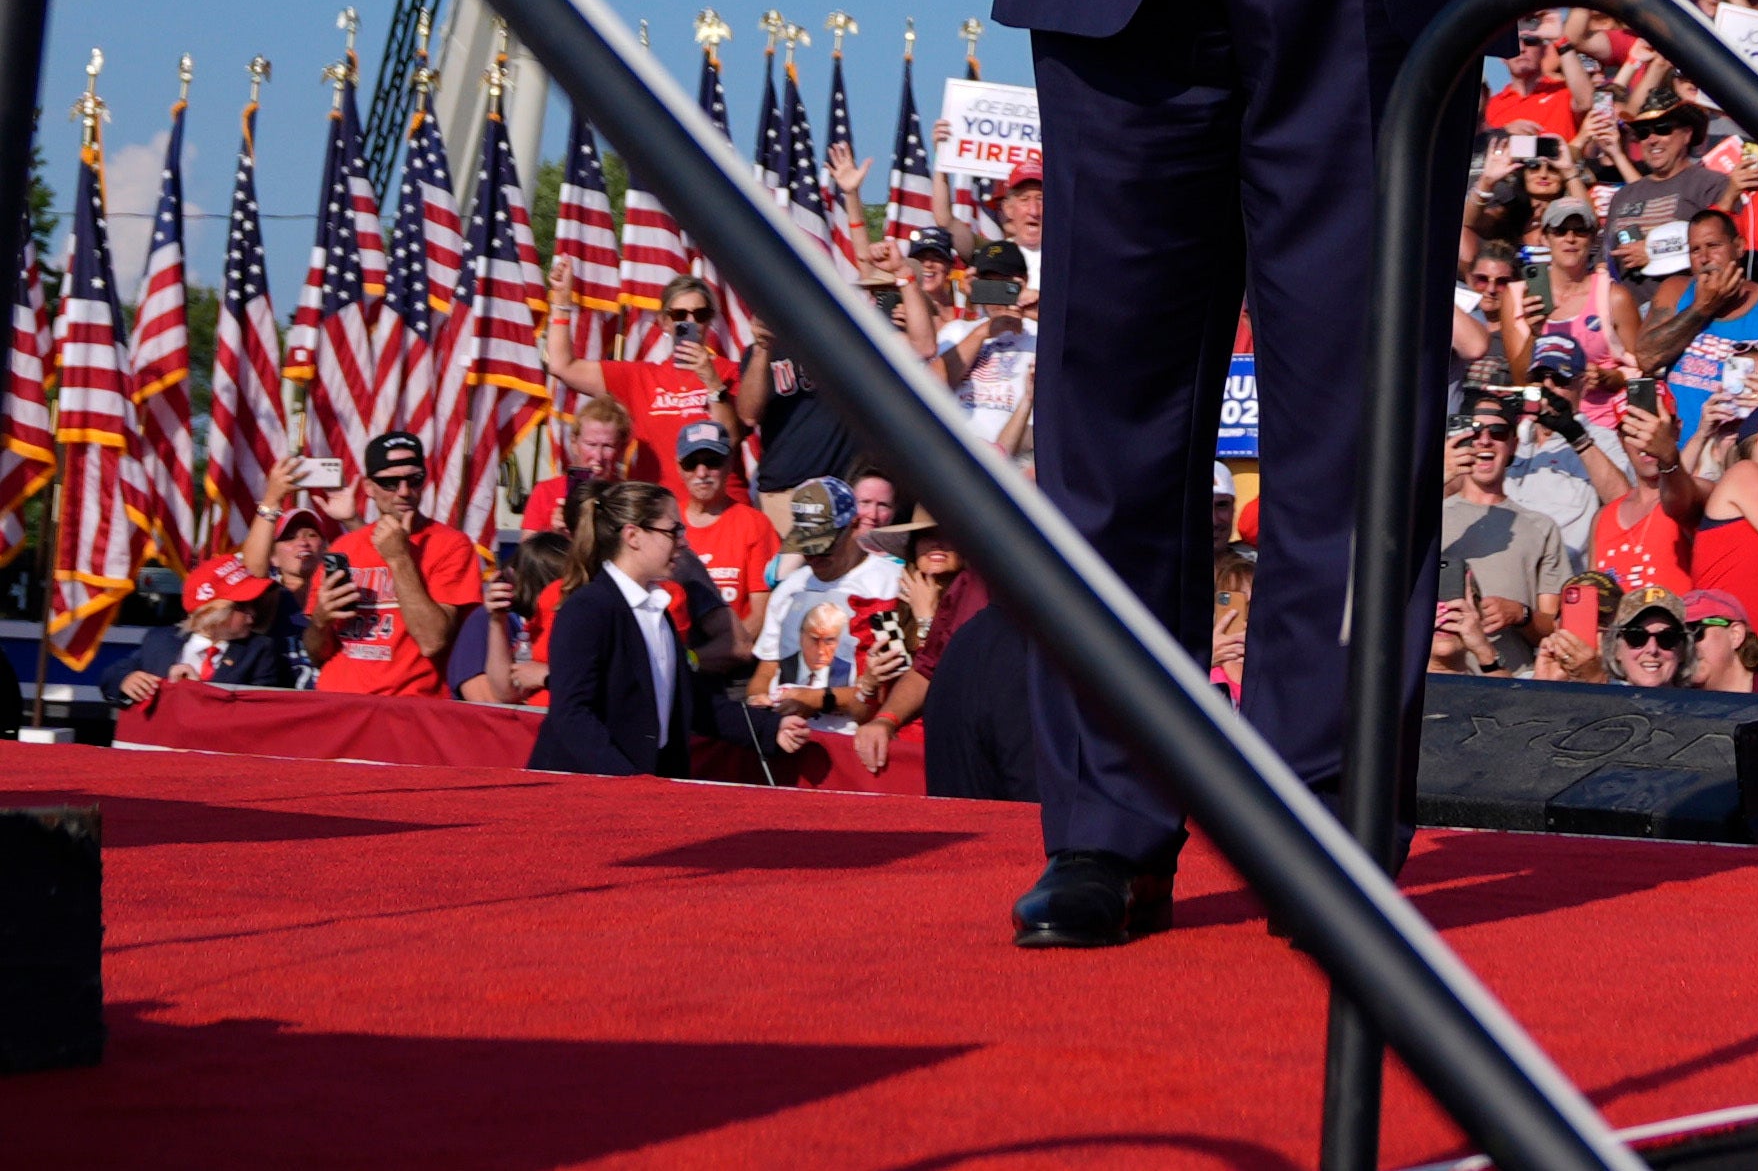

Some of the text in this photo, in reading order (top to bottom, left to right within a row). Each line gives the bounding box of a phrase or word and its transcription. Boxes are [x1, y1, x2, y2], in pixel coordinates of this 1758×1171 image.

[963, 115, 1042, 143] YOU'R
[1220, 399, 1260, 425] 02
[1644, 586, 1665, 604] P
